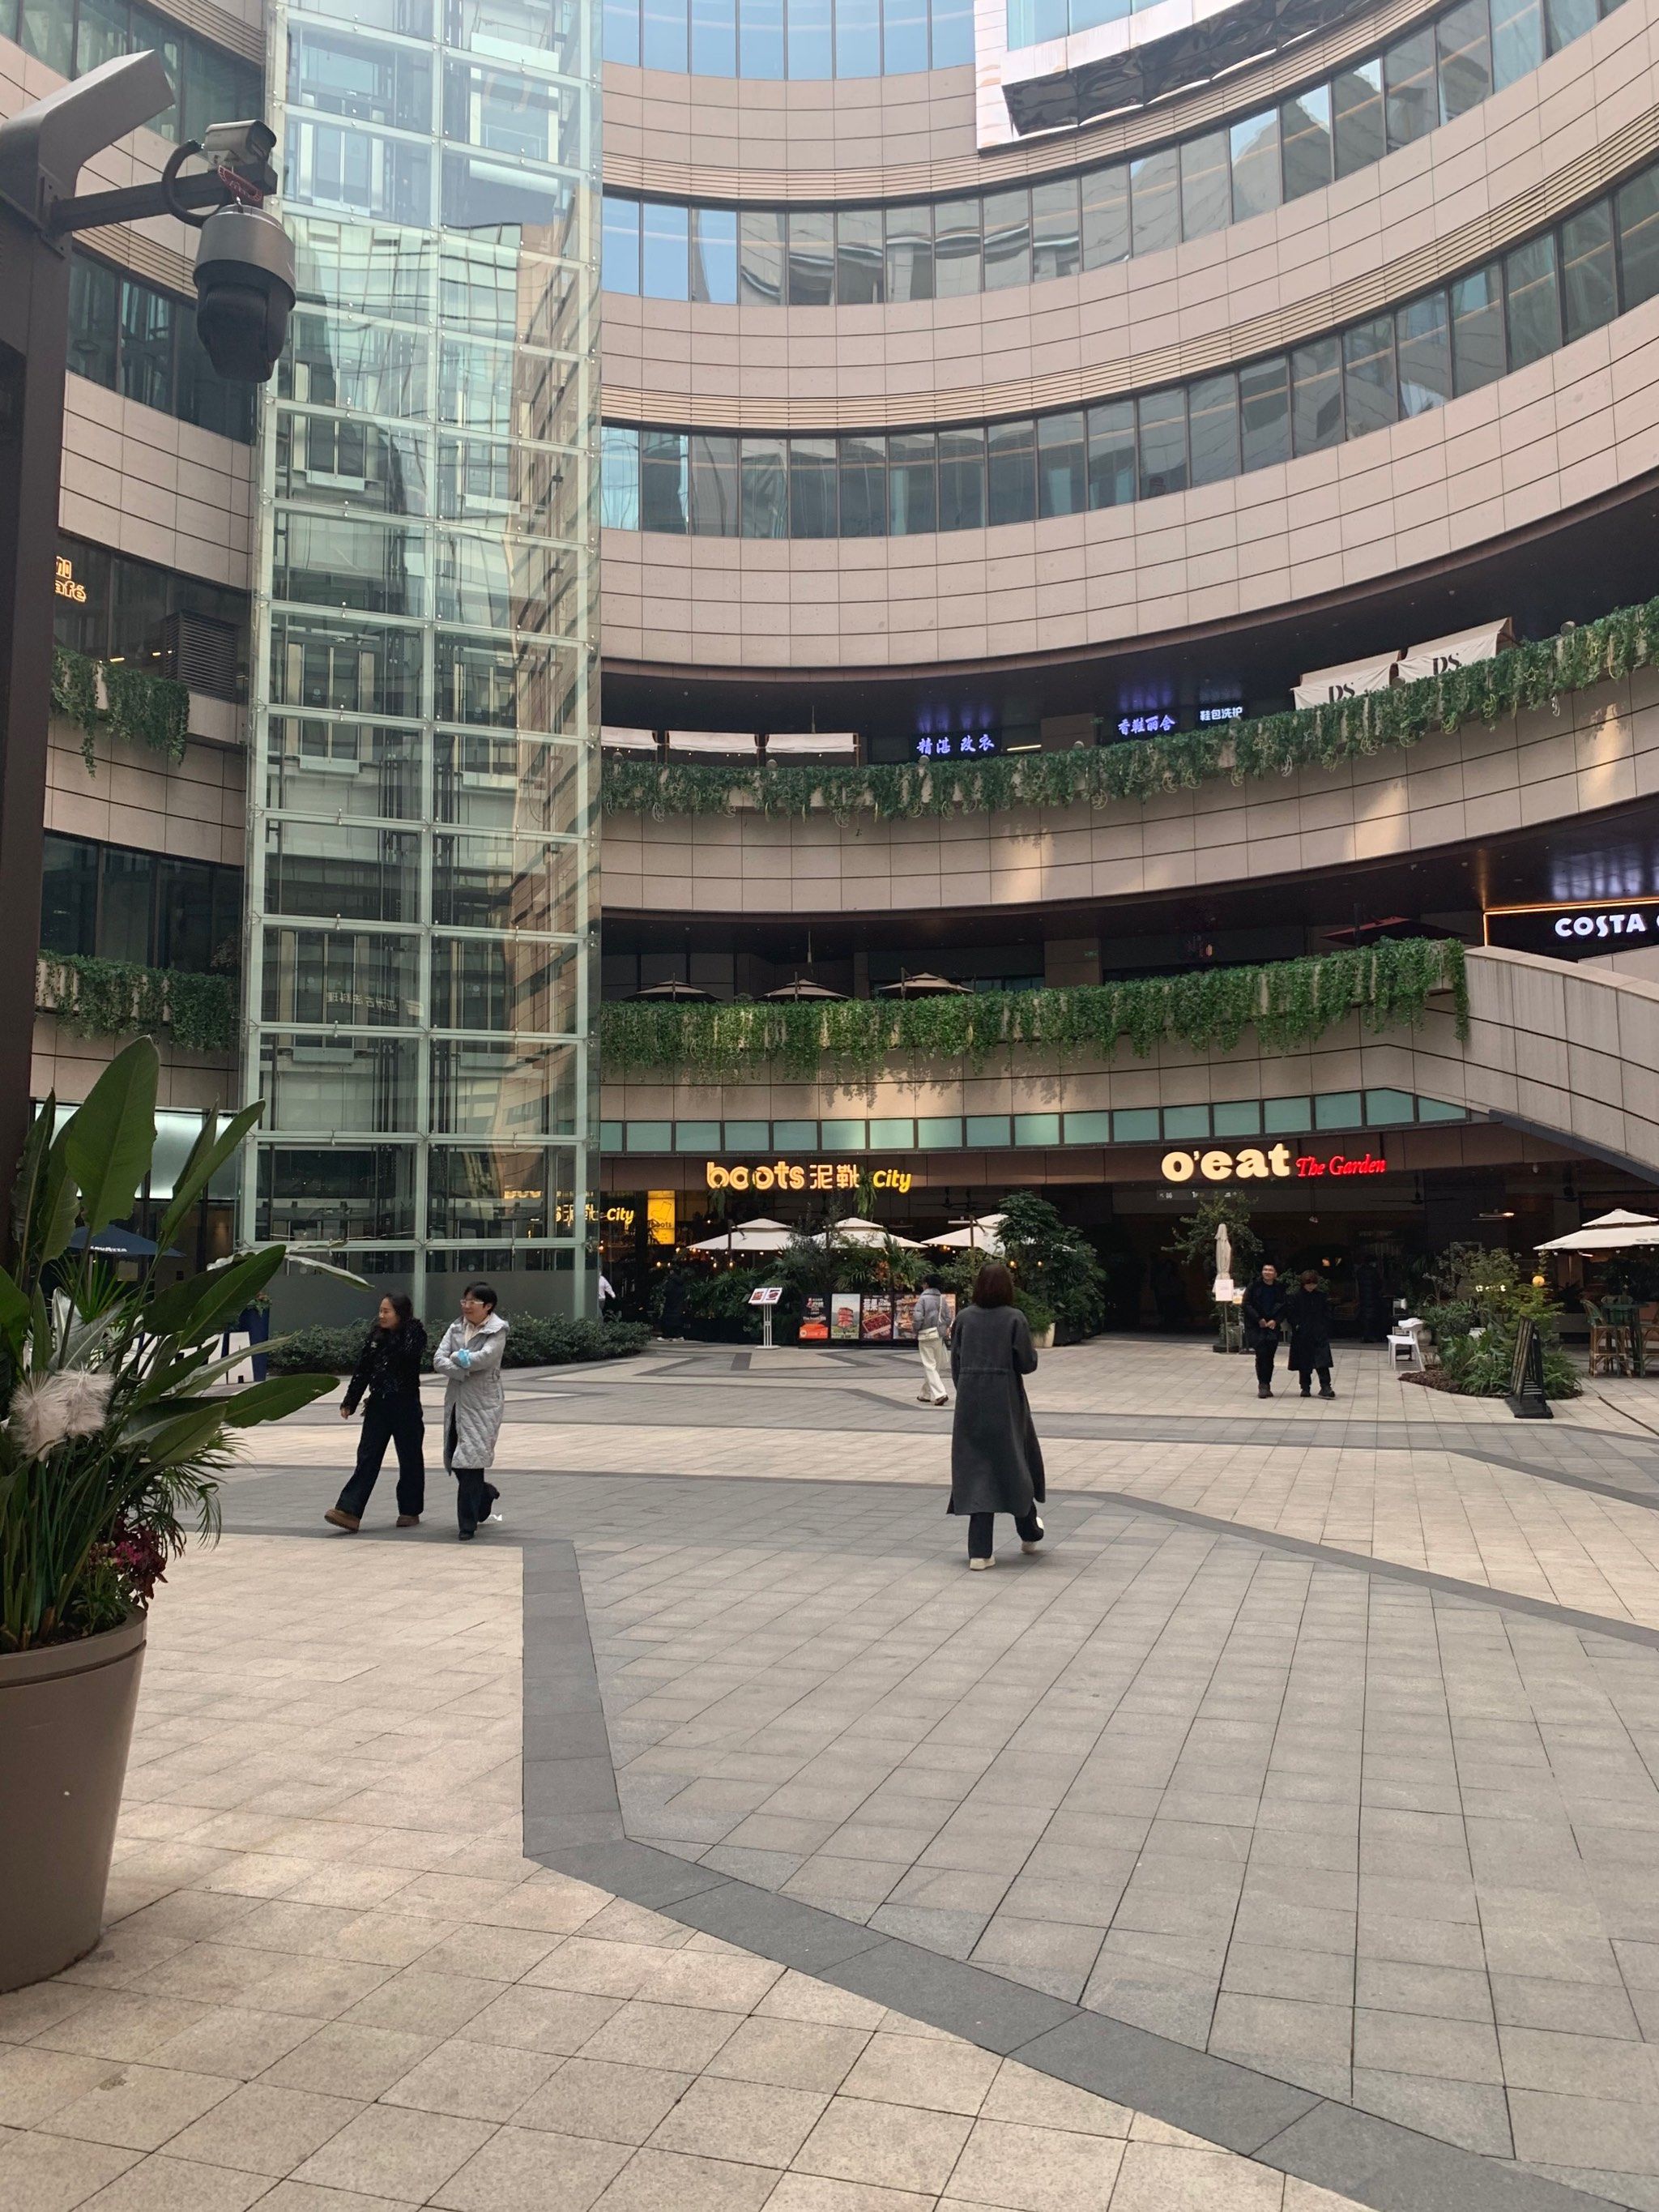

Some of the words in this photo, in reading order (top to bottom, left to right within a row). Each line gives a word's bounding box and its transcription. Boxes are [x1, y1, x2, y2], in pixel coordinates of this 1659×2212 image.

[55, 580, 87, 602] afé
[1200, 706, 1243, 722] 鞋包洗护
[916, 737, 951, 755] 精湛
[960, 733, 995, 753] 改衣
[1555, 913, 1646, 937] COSTA
[1161, 1142, 1291, 1182] o'eat
[1295, 1156, 1326, 1177] The
[1329, 1154, 1387, 1176] Garden
[706, 1161, 805, 1190] boots
[872, 1168, 912, 1194] City
[606, 1206, 635, 1225] City
